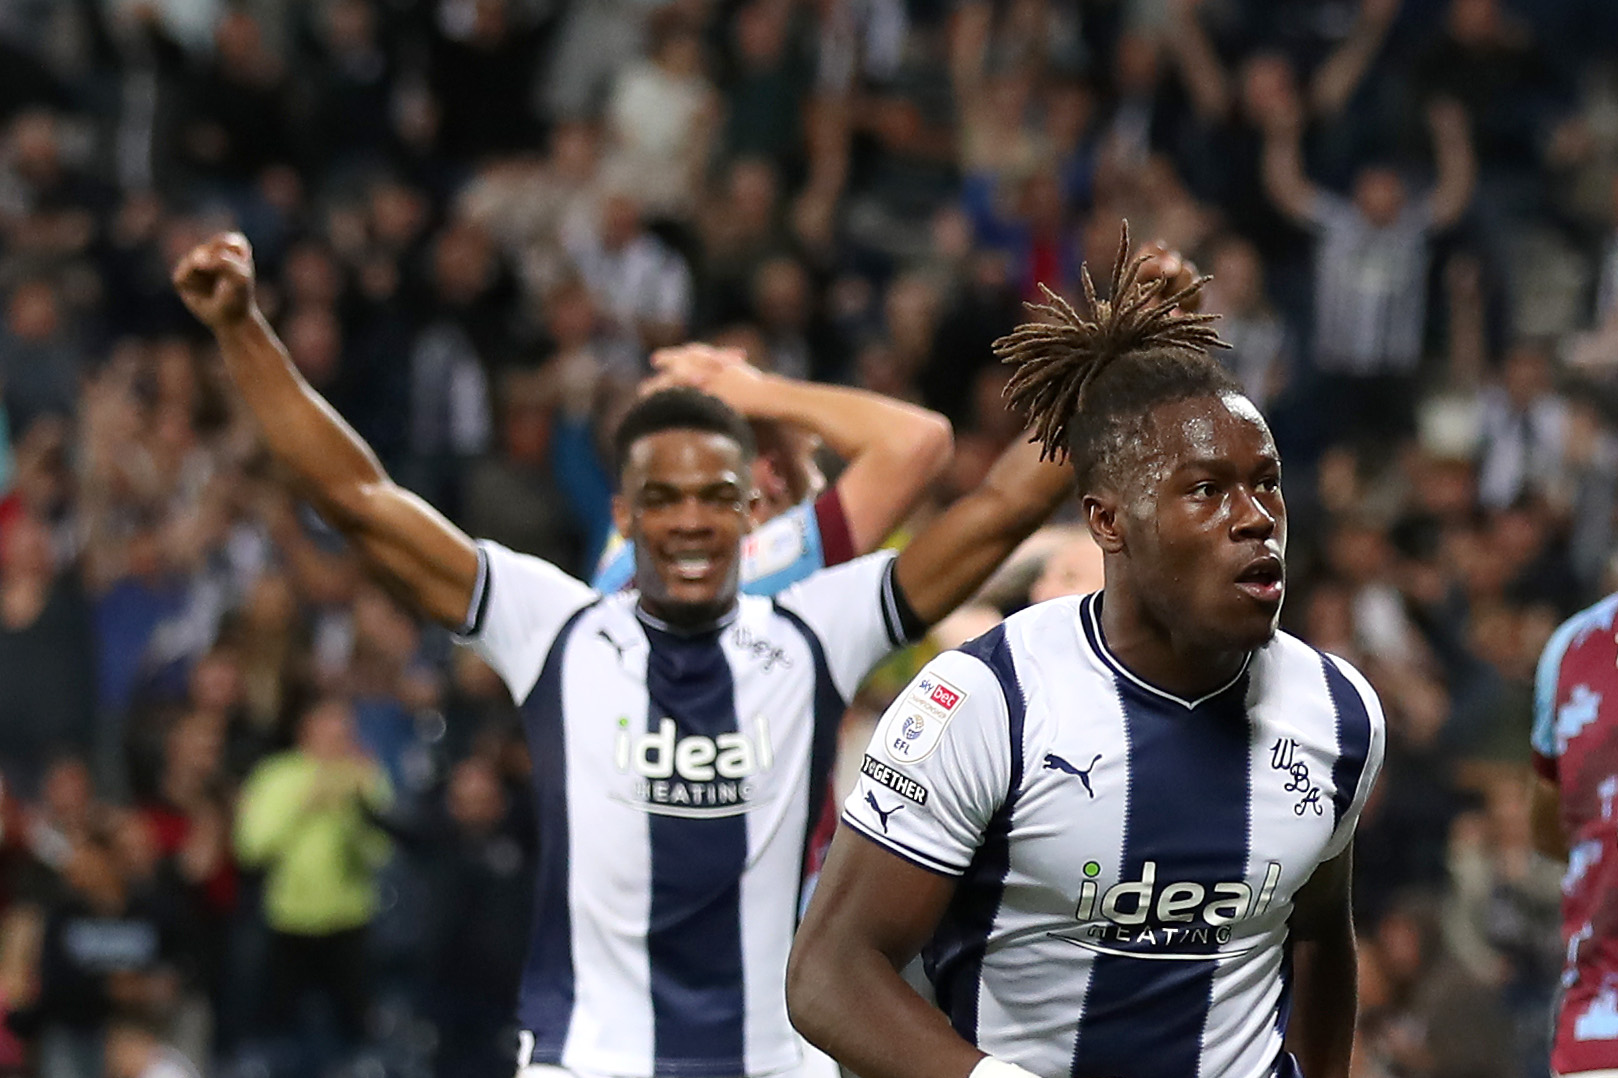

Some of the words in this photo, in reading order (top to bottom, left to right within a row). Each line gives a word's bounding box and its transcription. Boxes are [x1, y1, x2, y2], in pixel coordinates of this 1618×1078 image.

[918, 679, 935, 695] sky
[934, 686, 958, 707] bet
[614, 713, 774, 782] ideal
[893, 738, 909, 756] EFL
[863, 757, 926, 803] TOGETHER
[1075, 861, 1282, 927] ideal
[1088, 924, 1232, 945] HEATING
